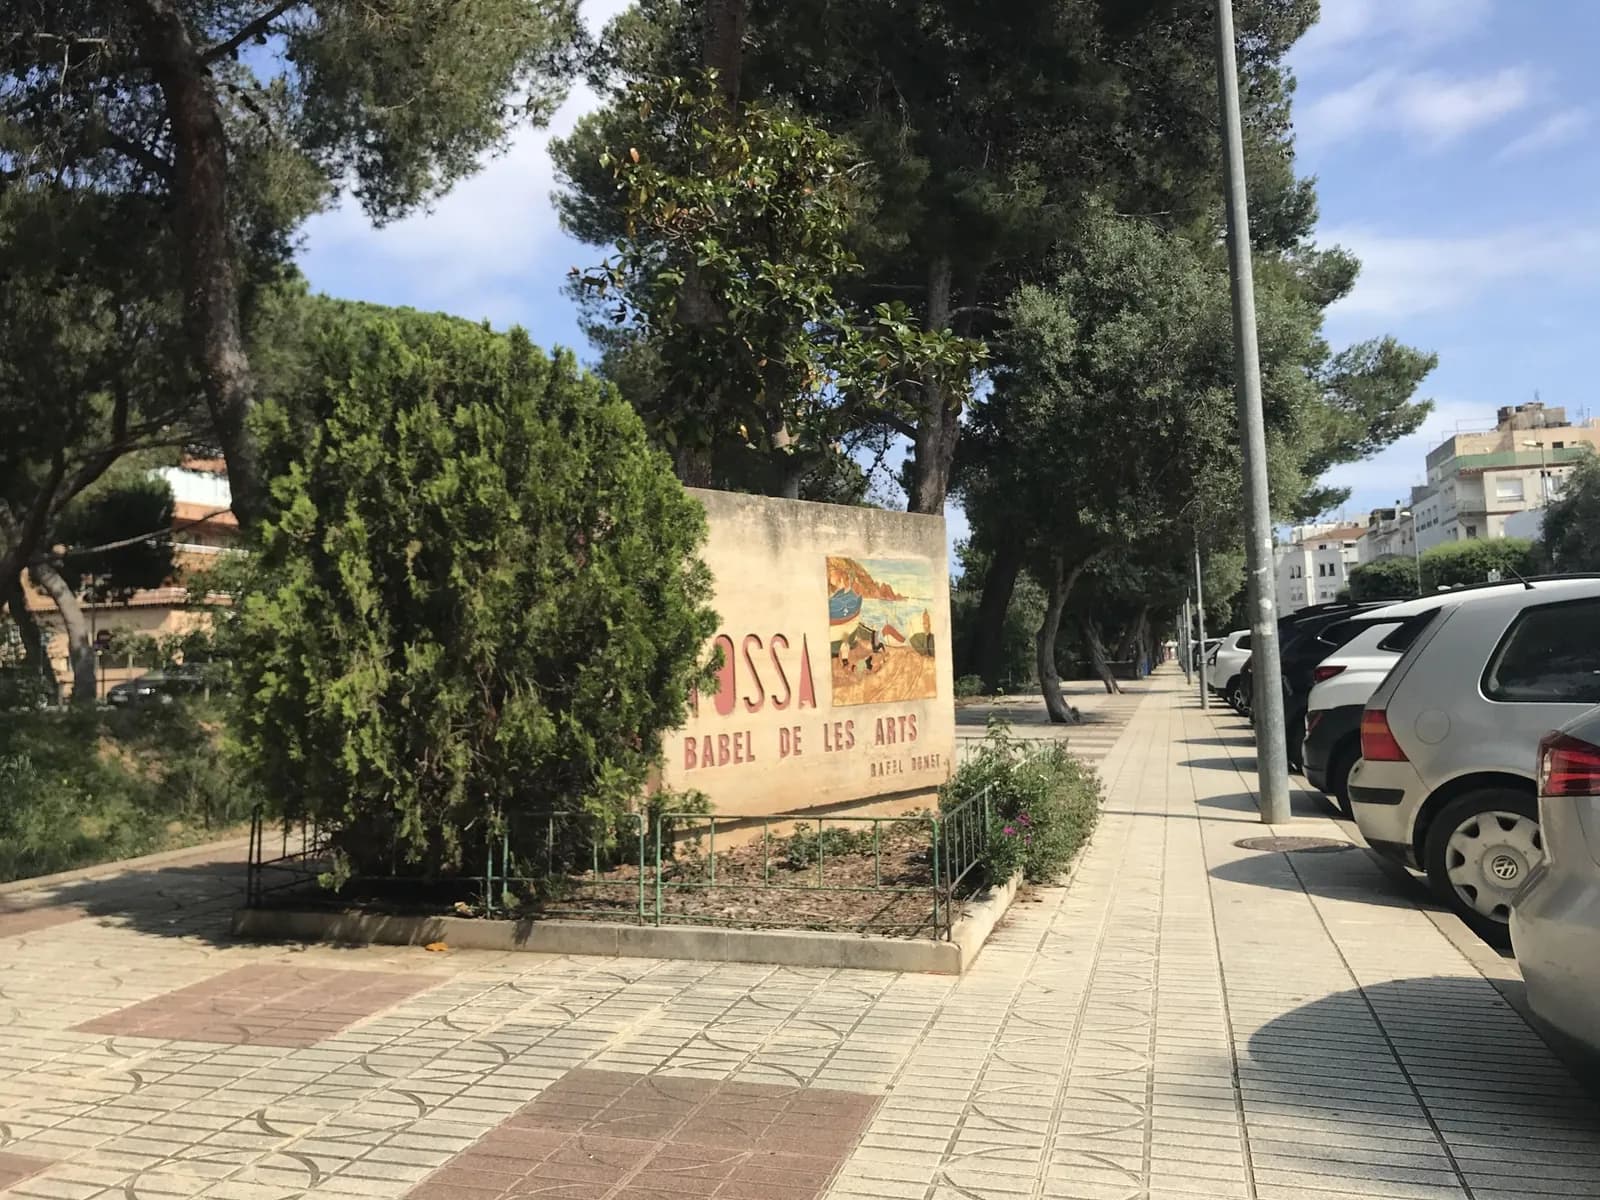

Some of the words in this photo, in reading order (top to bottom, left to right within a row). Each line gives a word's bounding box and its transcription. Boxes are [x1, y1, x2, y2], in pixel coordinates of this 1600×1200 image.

[684, 730, 756, 770] BABEL
[779, 726, 802, 758] DE
[824, 719, 855, 752] LES
[875, 713, 918, 746] ARTS
